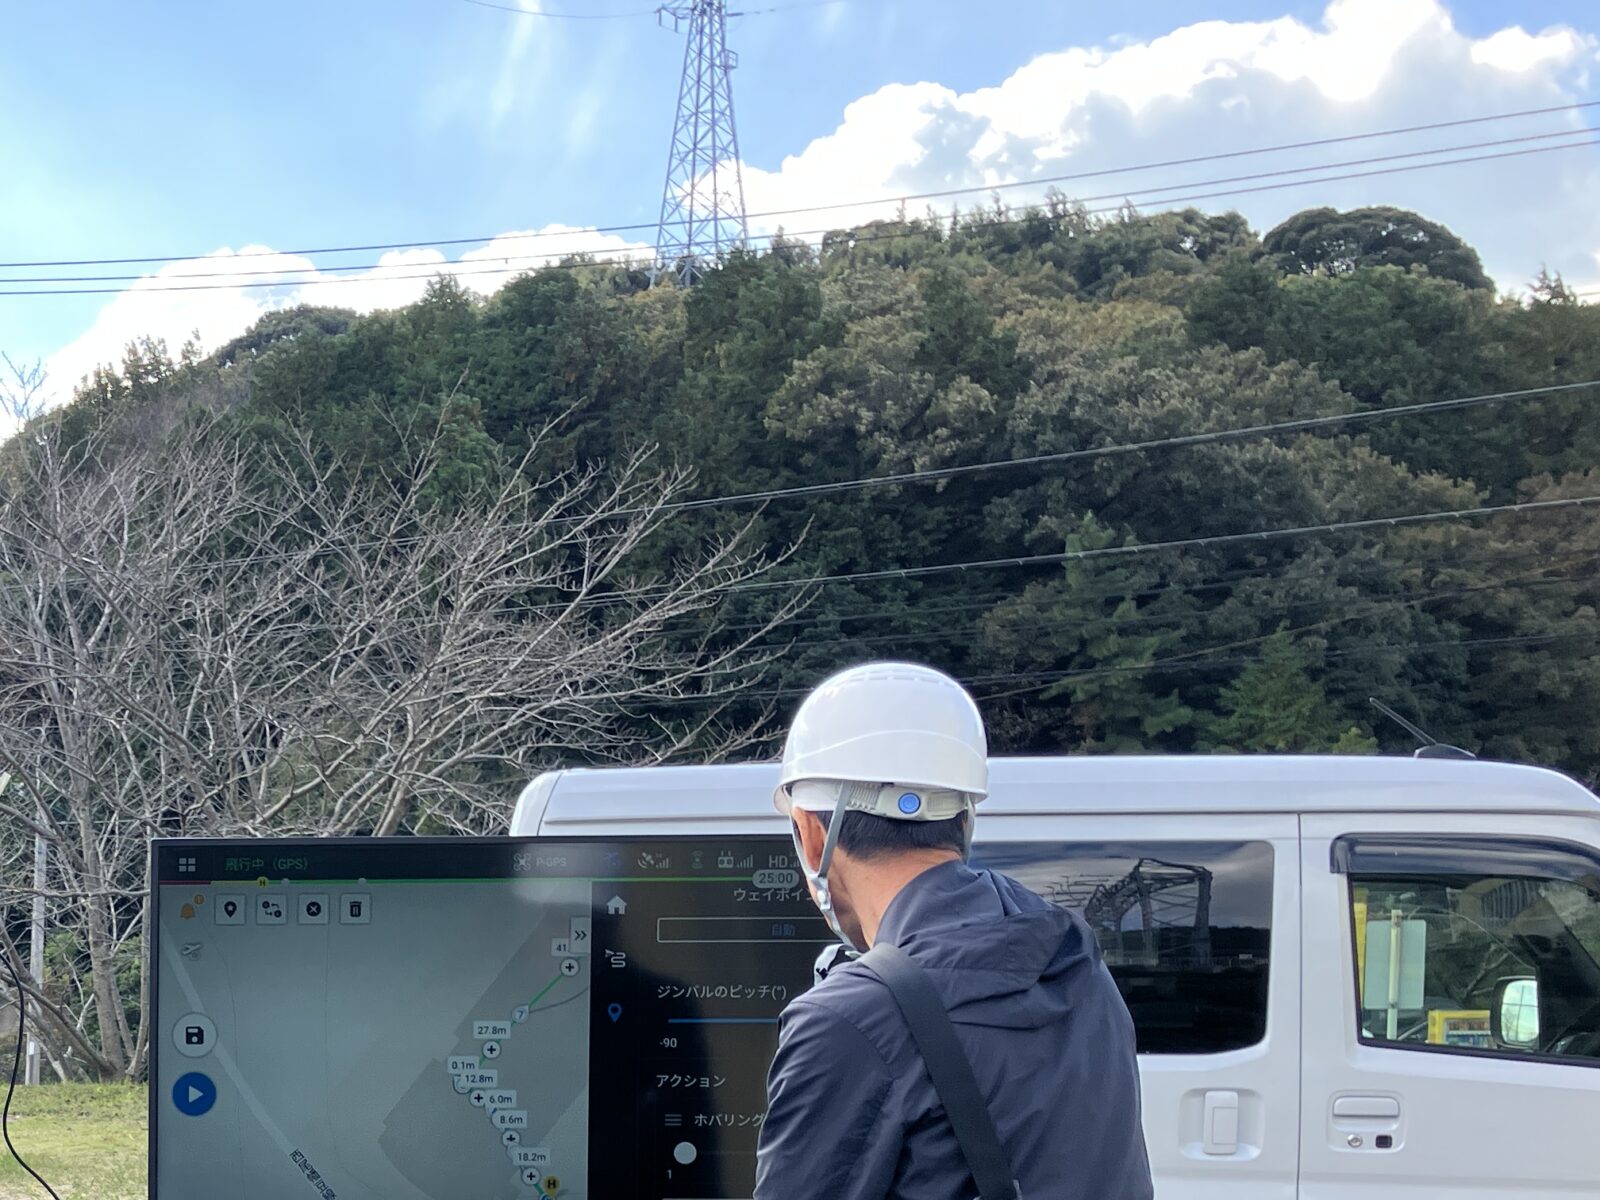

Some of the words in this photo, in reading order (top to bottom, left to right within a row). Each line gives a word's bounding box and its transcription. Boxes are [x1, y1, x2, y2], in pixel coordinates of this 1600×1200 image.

[768, 855, 788, 869] HD
[758, 872, 794, 885] 25:00
[733, 887, 812, 902] ウェイポイ
[477, 1025, 507, 1037] 27.8m
[659, 1037, 678, 1049] -90
[451, 1059, 475, 1071] 0.1m
[464, 1073, 494, 1085] 12.8m
[656, 1074, 726, 1089] アクション
[489, 1093, 513, 1105] 6.0m
[499, 1114, 524, 1126] 8.6m
[694, 1112, 765, 1127] ホバリング
[517, 1151, 547, 1163] 18.2m
